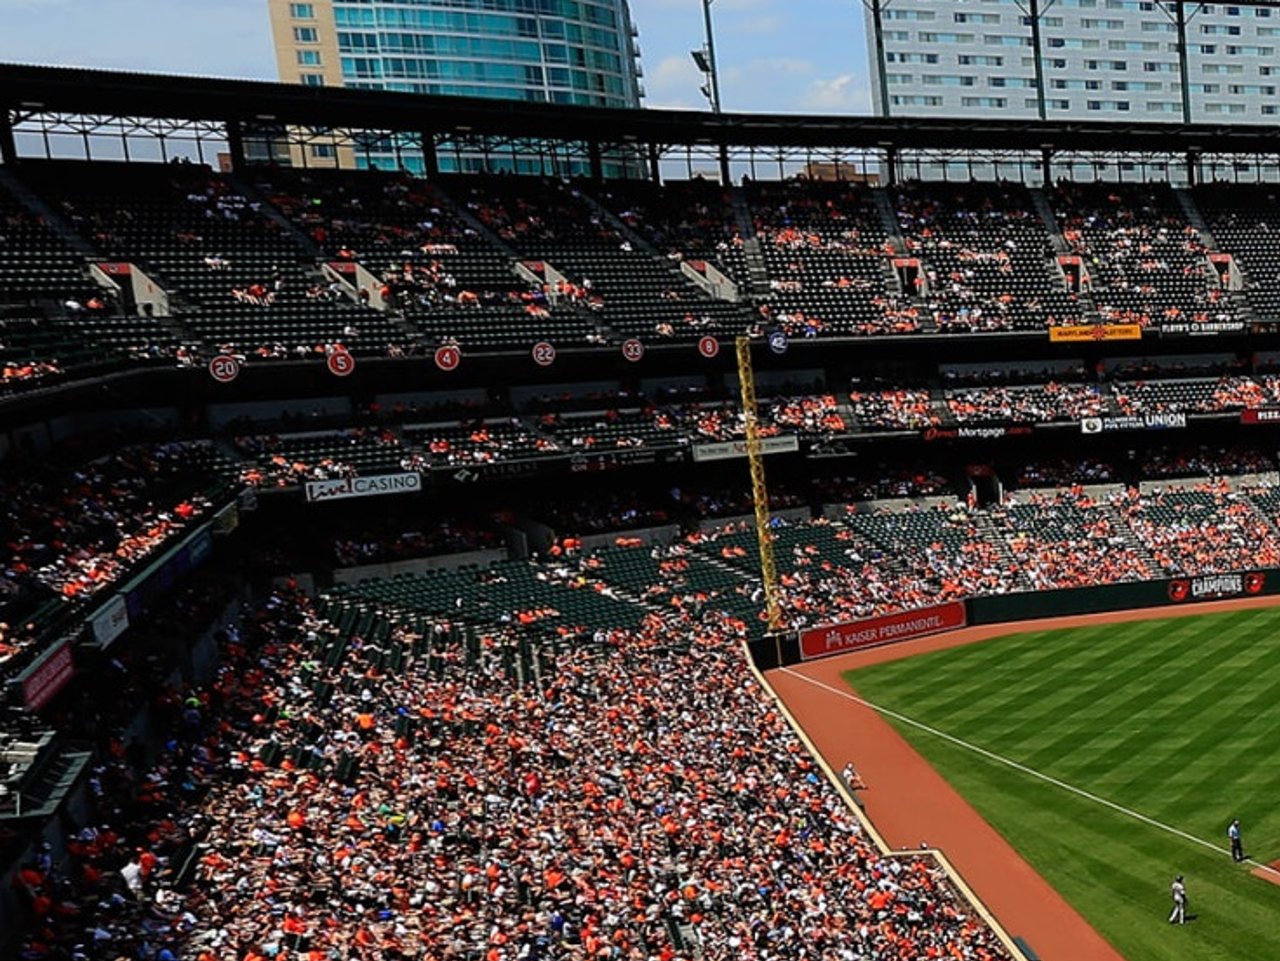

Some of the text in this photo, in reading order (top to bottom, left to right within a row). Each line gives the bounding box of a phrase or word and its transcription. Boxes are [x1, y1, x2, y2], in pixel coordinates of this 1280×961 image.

[536, 347, 554, 361] 22
[627, 344, 641, 356] 33
[337, 356, 346, 370] 5
[443, 352, 451, 365] 4
[214, 361, 235, 376] 20
[1145, 413, 1186, 427] UNION
[958, 427, 1005, 438] Mortgage
[354, 474, 418, 493] CASINO
[1191, 577, 1243, 596] CHAMPIONS
[844, 627, 878, 645] KAISER
